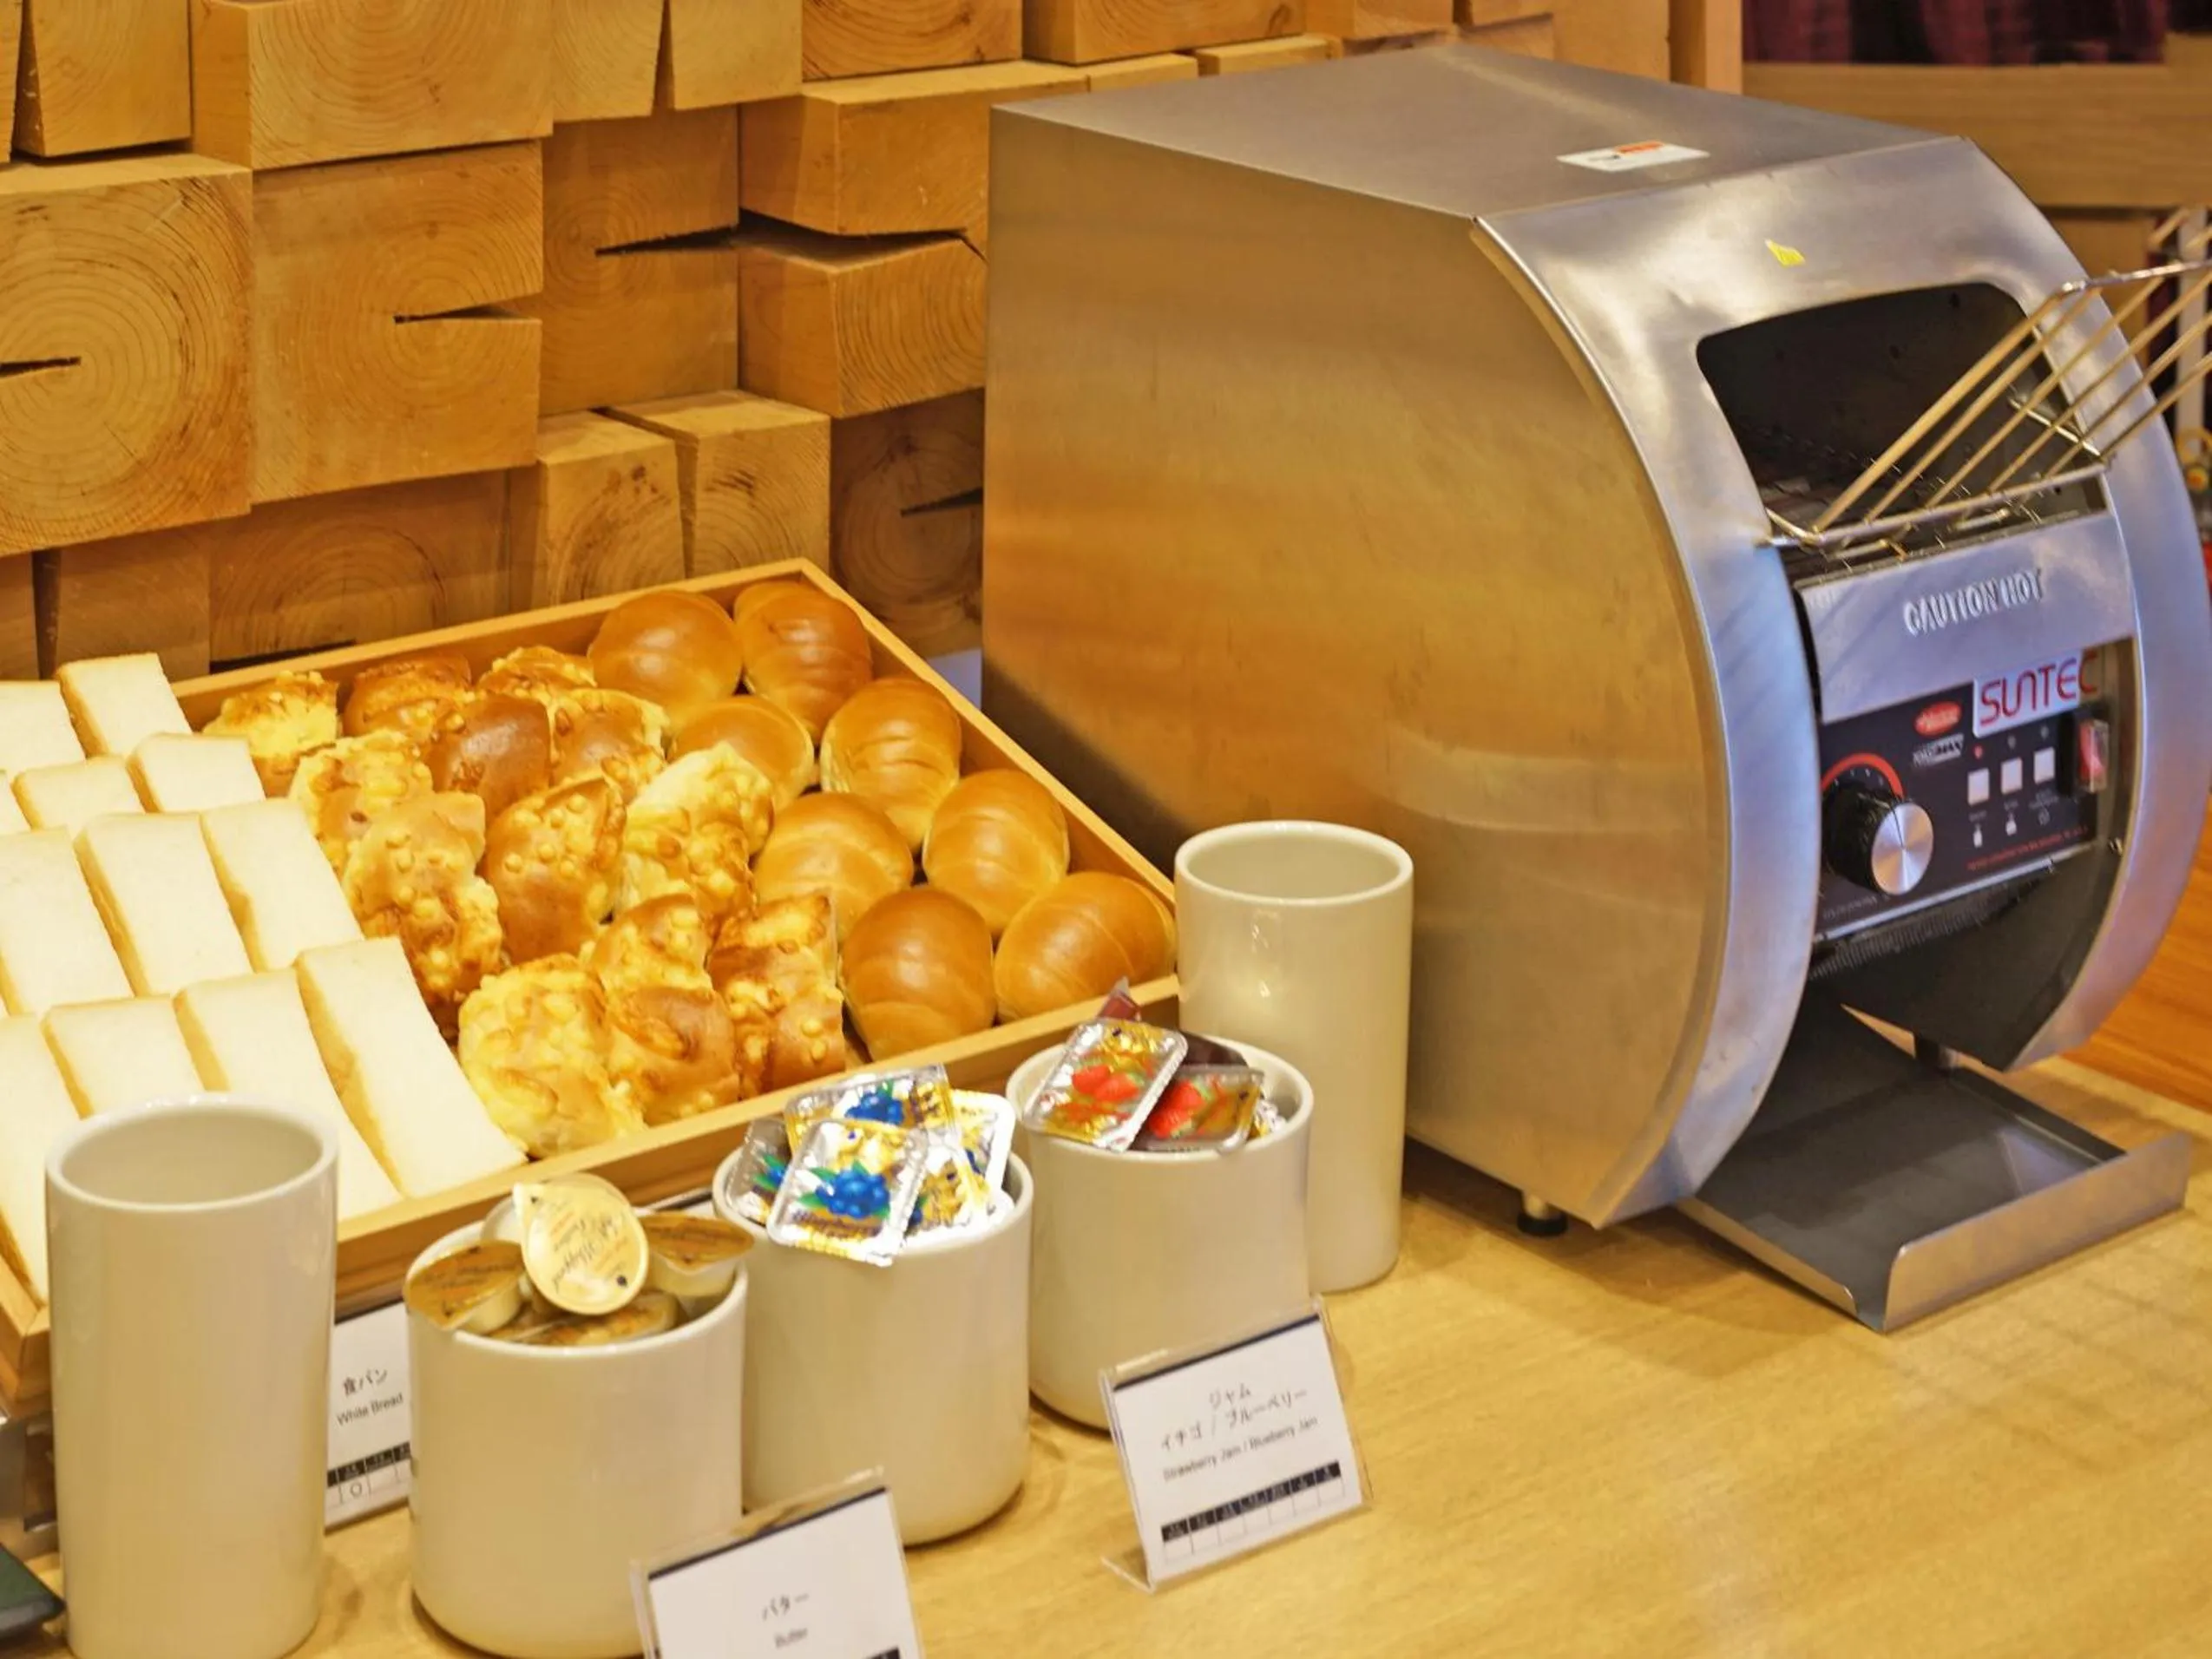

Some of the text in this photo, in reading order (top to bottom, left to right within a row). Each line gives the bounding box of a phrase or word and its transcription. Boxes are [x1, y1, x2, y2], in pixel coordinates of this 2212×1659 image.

[1903, 577, 1998, 637] CAUTION
[1979, 648, 2099, 727] SUNTEC
[336, 1392, 404, 1425] White Bread
[1163, 1454, 1217, 1482] Strawberry
[1250, 1426, 1296, 1451] Blueberry
